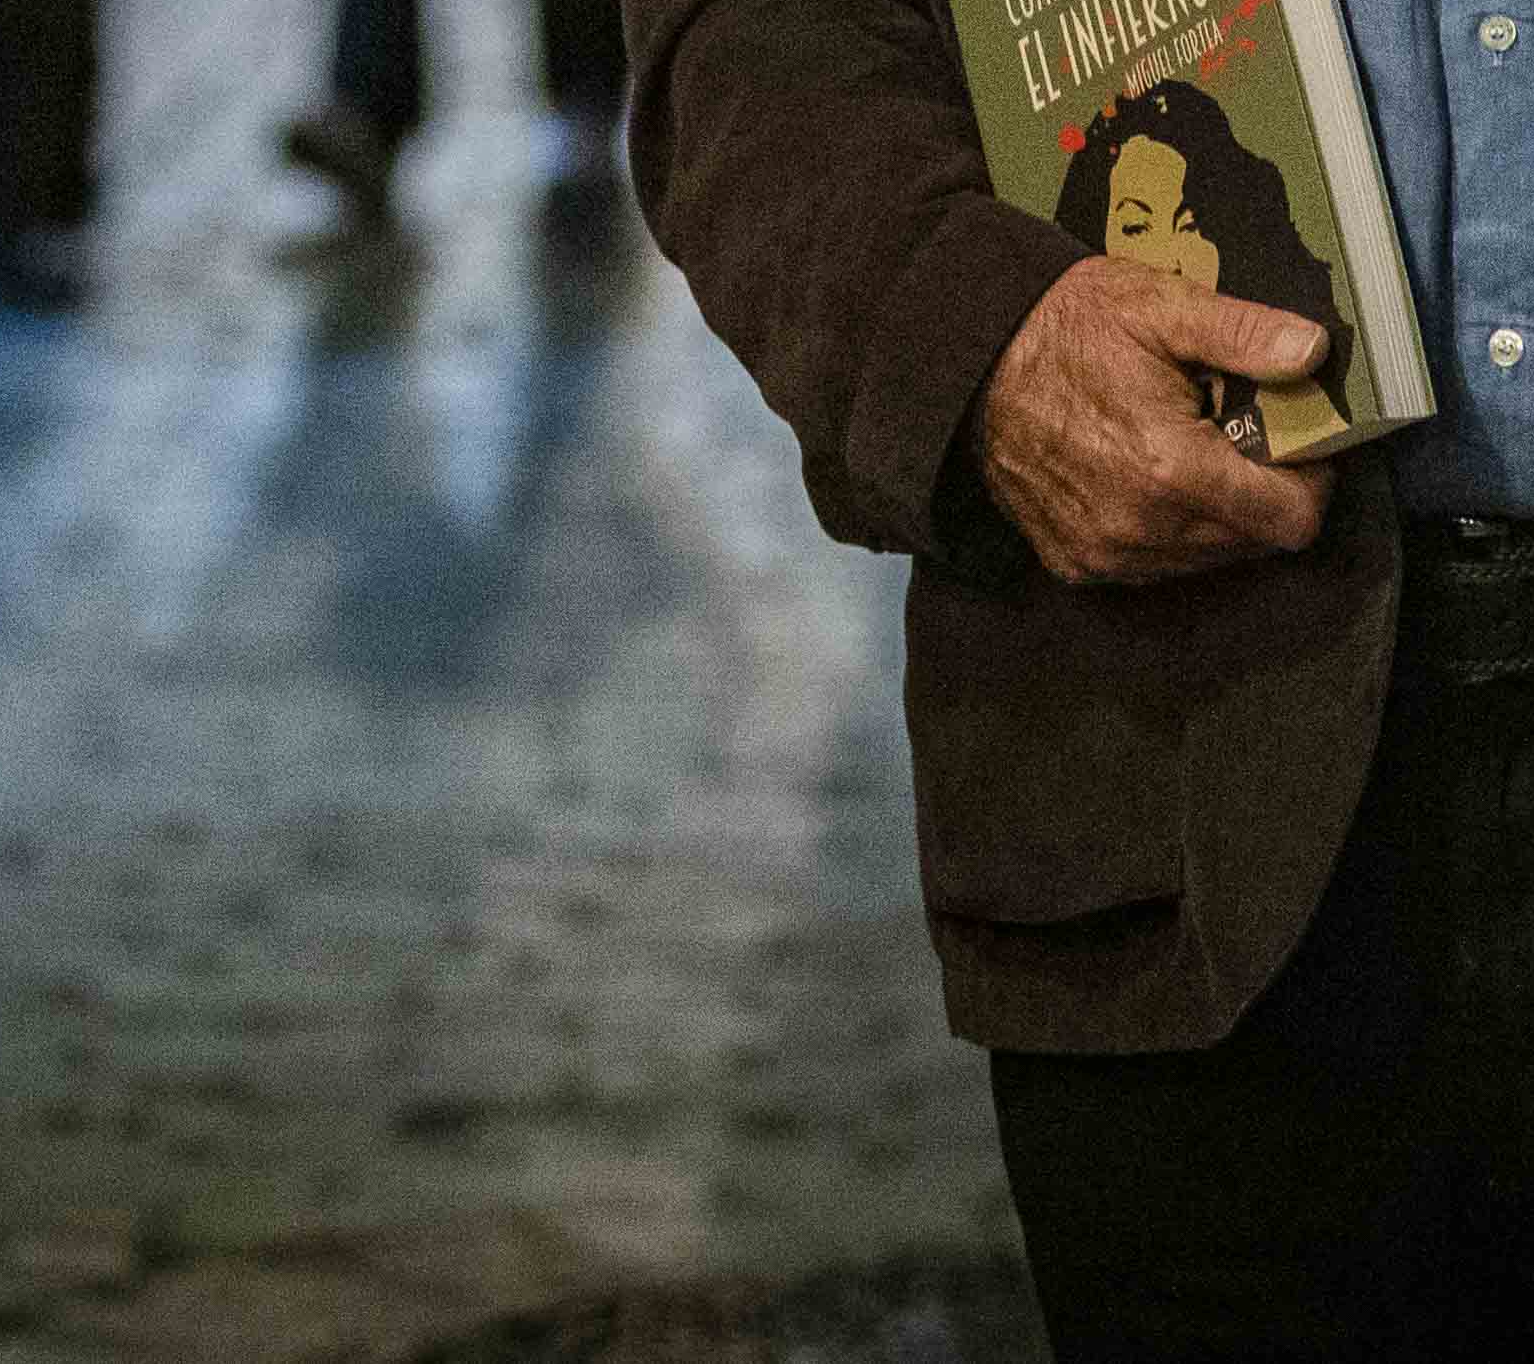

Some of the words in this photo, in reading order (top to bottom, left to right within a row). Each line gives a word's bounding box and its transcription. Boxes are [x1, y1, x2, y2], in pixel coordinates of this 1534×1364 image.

[1018, 29, 1062, 112] EL
[1125, 44, 1176, 101] MIGUEL
[1174, 14, 1224, 69] FORTEA
